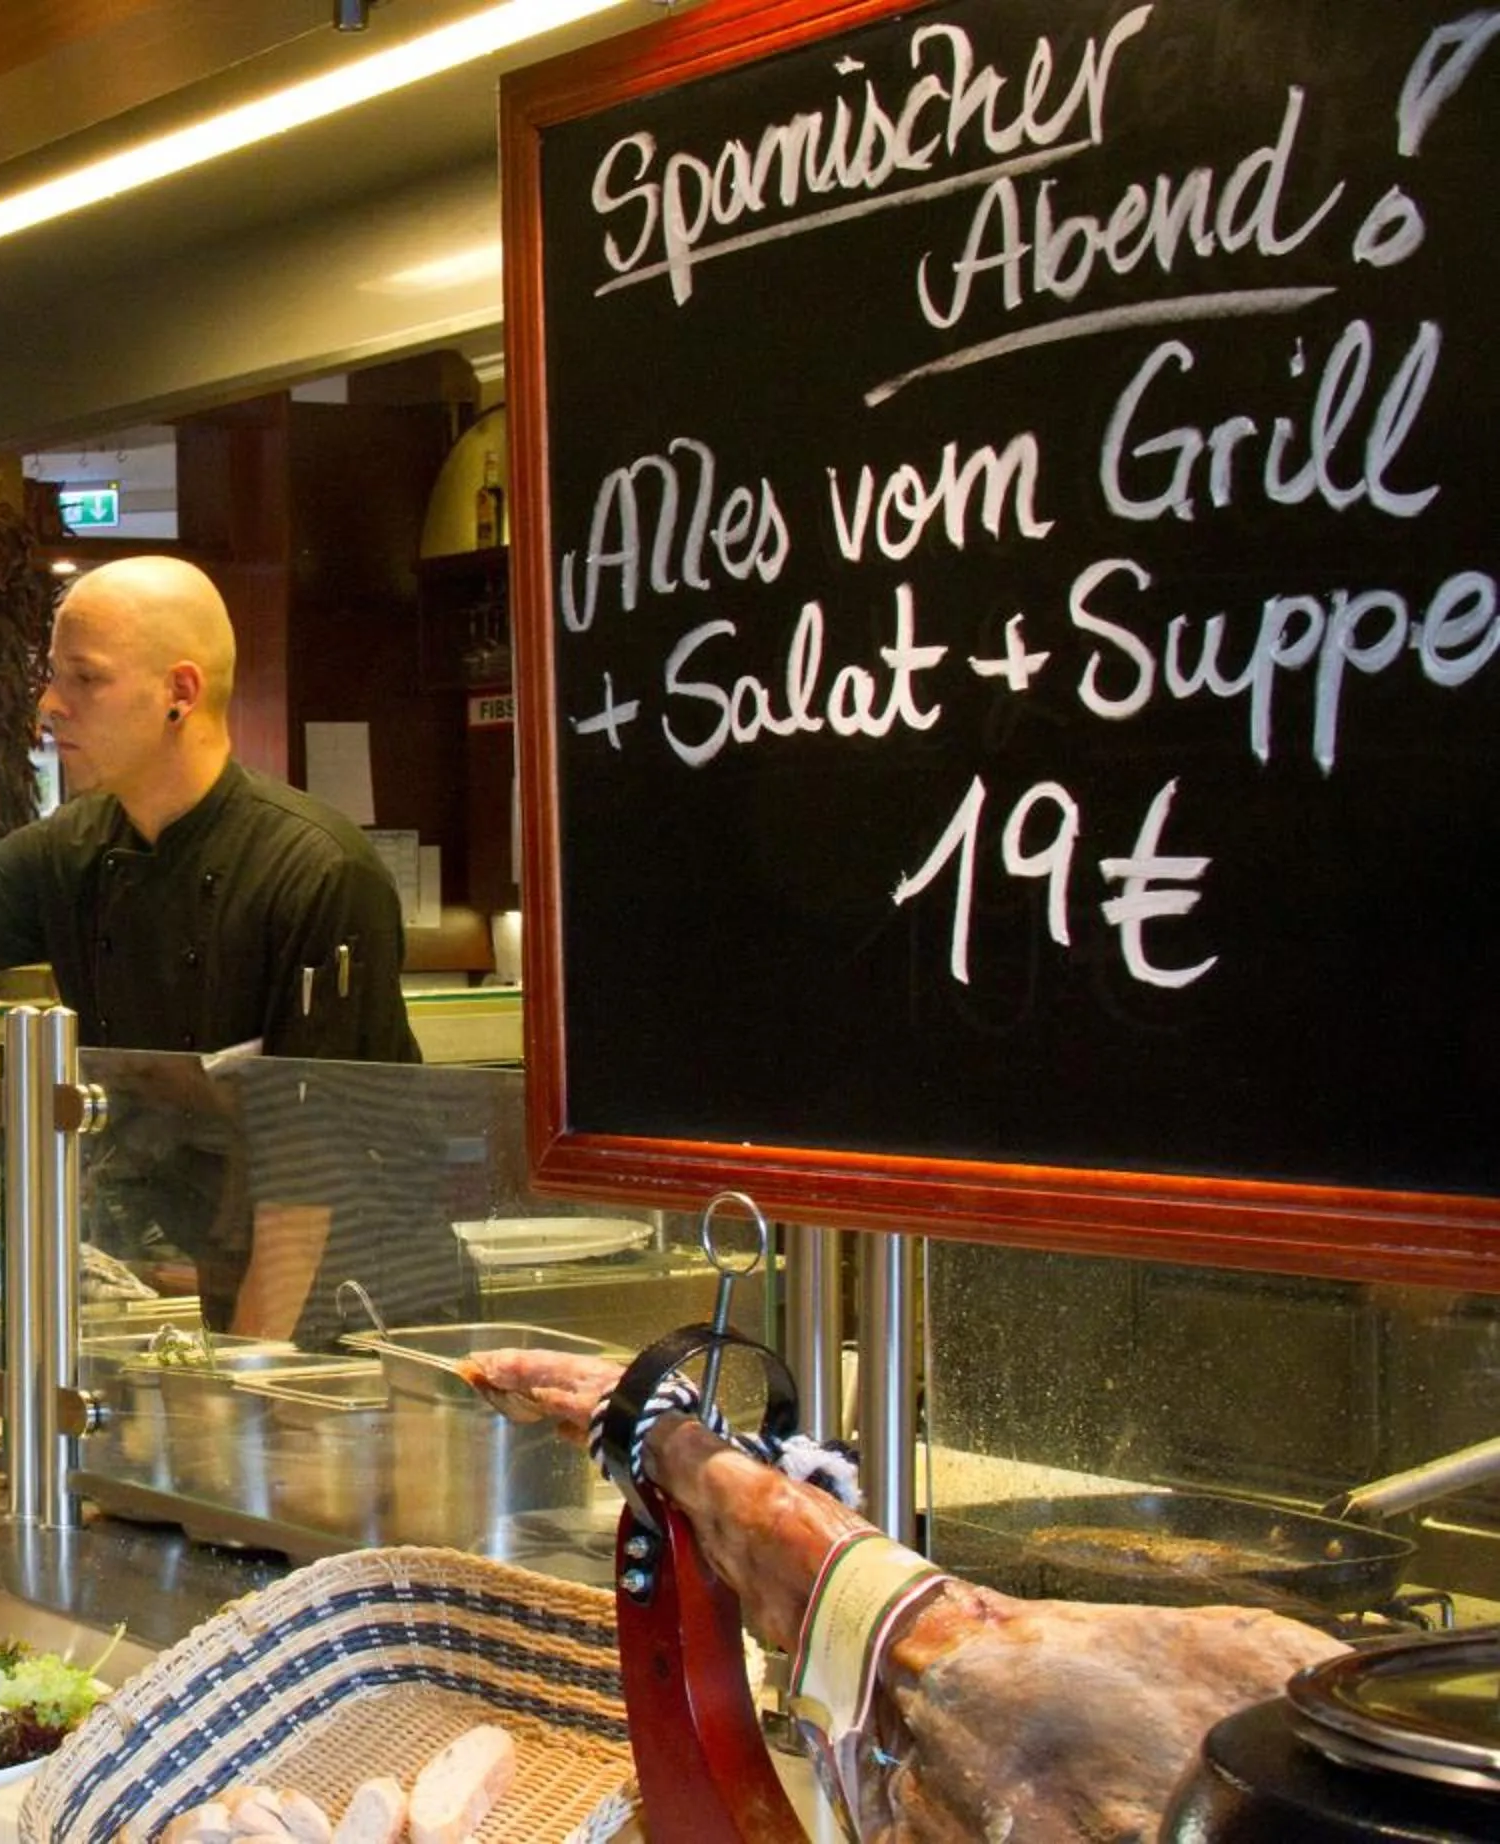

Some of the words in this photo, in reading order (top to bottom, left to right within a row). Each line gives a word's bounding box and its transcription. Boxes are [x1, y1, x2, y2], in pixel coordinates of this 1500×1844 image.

[590, 3, 1156, 306] Spanischer
[560, 436, 790, 633] Alles
[826, 432, 1055, 563] vom
[1100, 319, 1441, 522] Grill
[660, 582, 950, 768] Salat
[1067, 558, 1500, 776] Suppe
